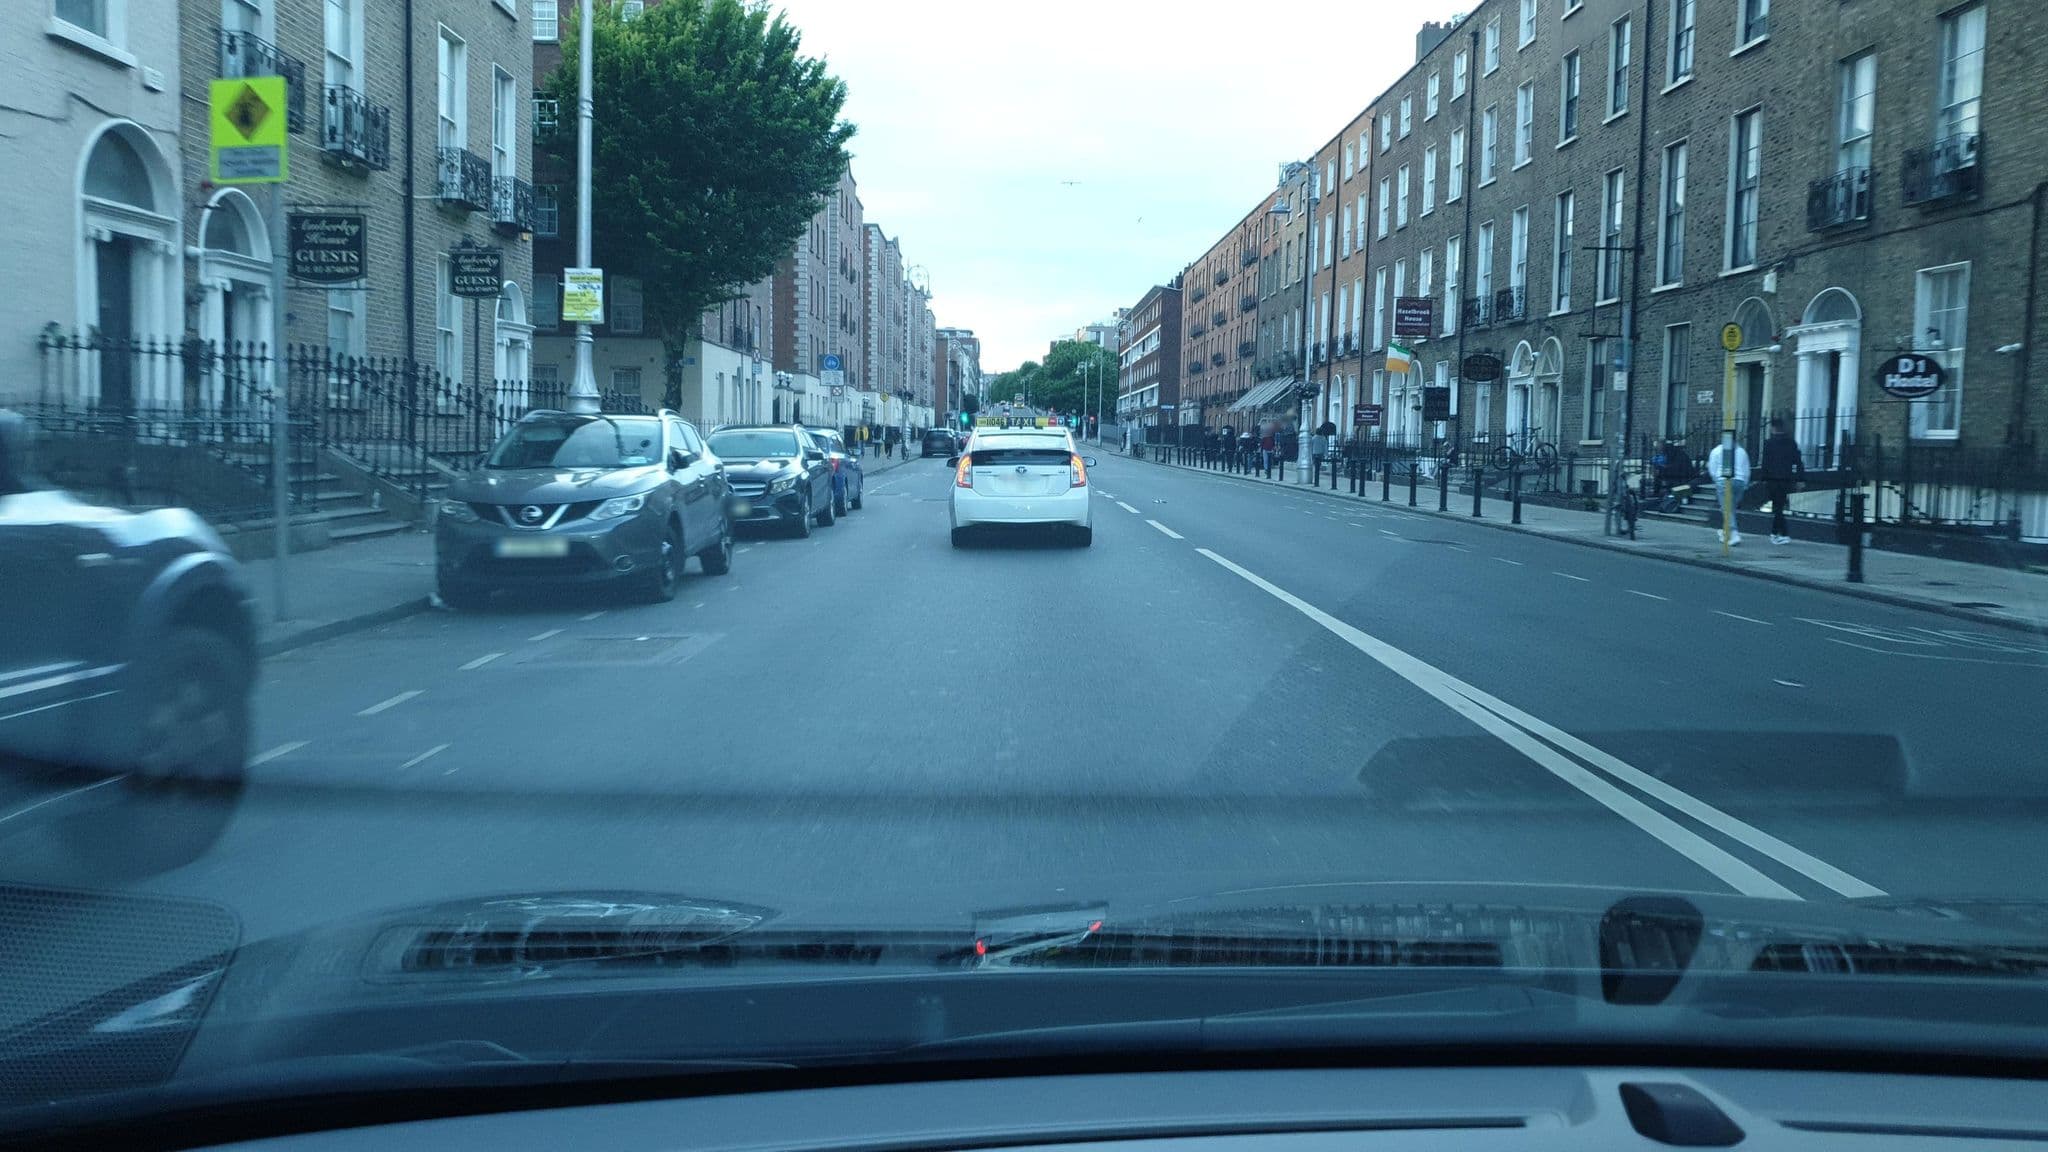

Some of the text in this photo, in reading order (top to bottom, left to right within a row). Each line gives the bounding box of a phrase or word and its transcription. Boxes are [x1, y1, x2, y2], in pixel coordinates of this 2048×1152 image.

[296, 249, 359, 263] GUESTS
[454, 275, 498, 285] GUESTS
[1011, 417, 1033, 426] TAXI
